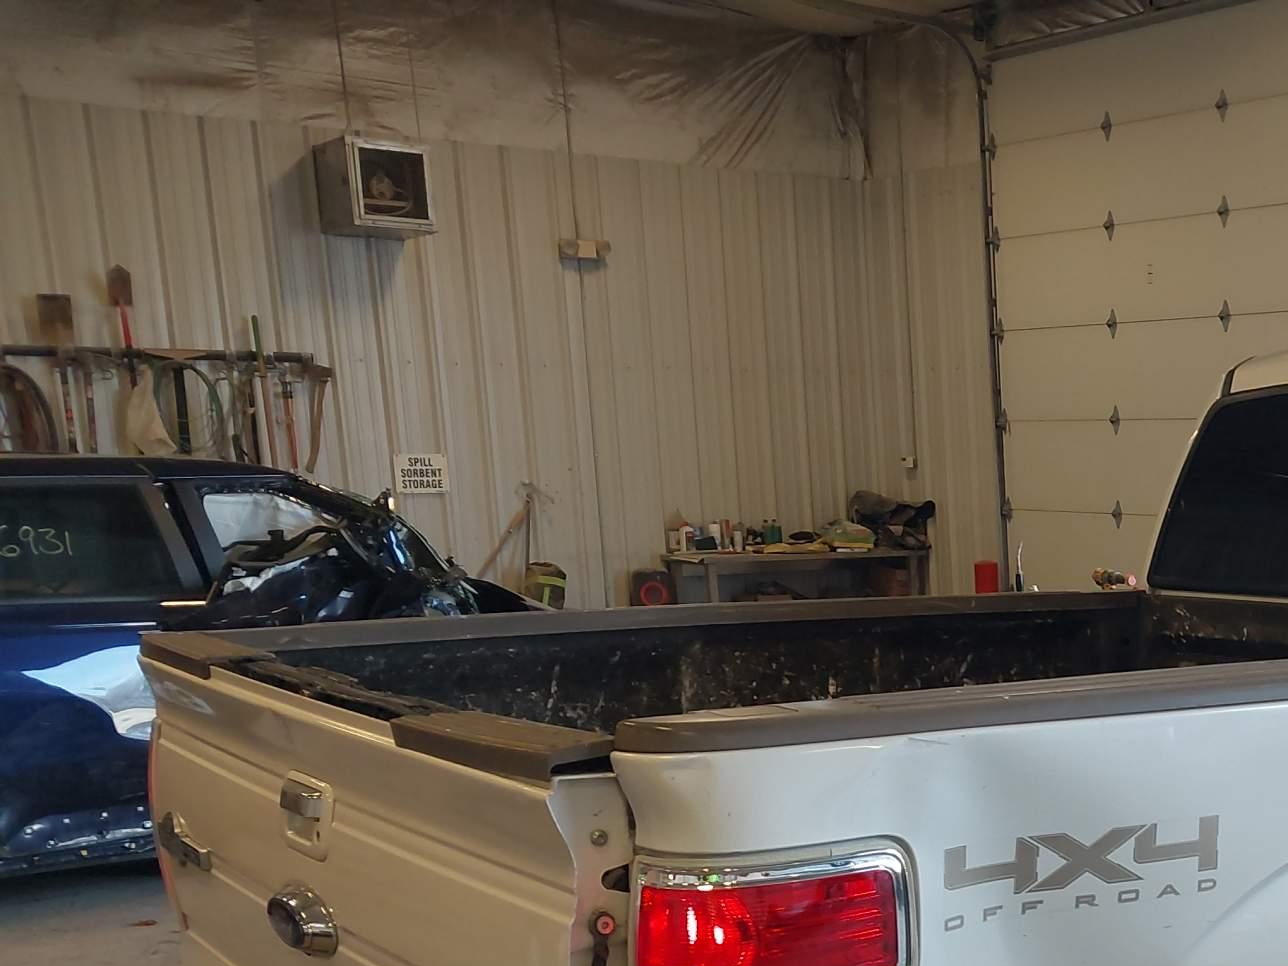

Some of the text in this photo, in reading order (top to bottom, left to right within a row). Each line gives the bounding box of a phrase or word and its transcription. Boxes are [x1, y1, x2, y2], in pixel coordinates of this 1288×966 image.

[408, 457, 433, 467] SPILL
[400, 468, 442, 478] SORBENT
[401, 479, 443, 489] STORAGE
[943, 815, 1219, 894] 4X4
[944, 878, 1218, 932] OFF ROAD
